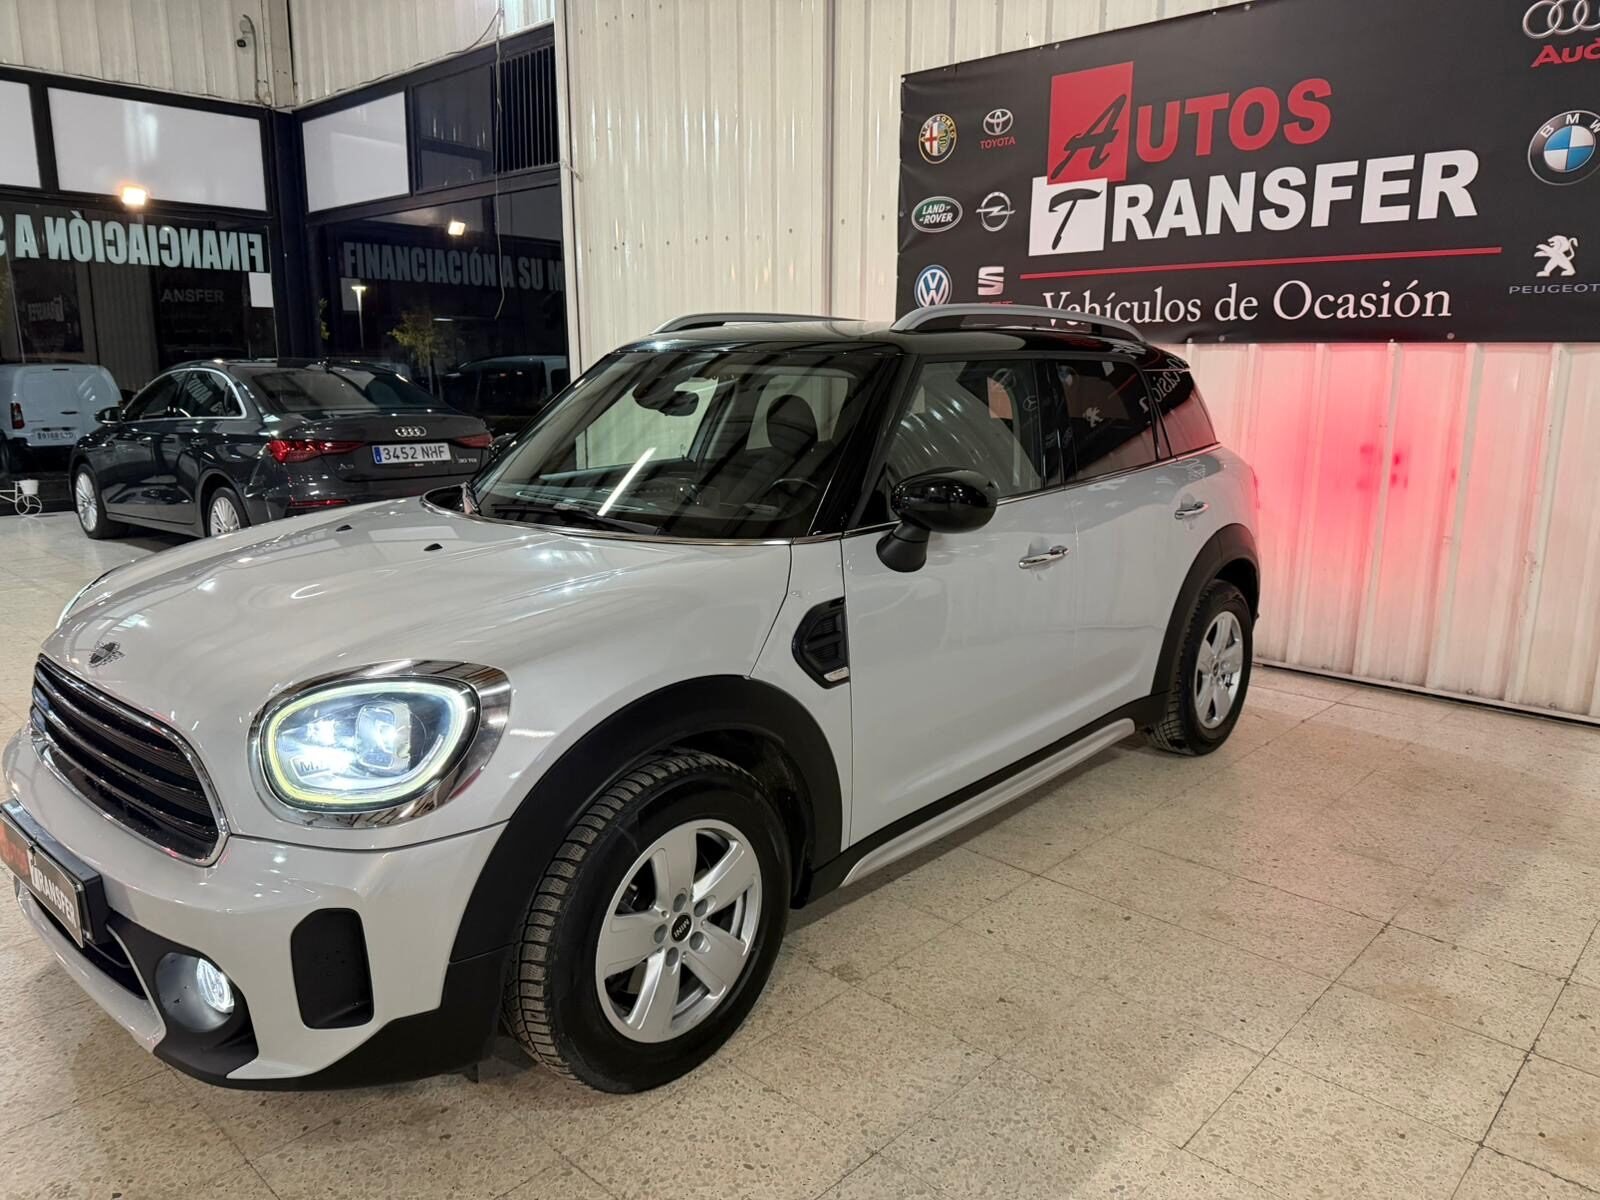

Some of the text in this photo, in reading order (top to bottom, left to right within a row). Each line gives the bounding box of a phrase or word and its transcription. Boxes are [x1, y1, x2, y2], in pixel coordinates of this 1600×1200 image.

[1051, 78, 1333, 181] AUTOS
[980, 136, 1016, 150] TOYOTA
[1047, 149, 1479, 250] TRANSFER
[922, 203, 945, 215] LAND
[923, 213, 953, 225] ROVER
[343, 241, 497, 287] FINANCIACIÓN
[501, 254, 515, 289] A
[518, 256, 543, 291] SU
[1509, 283, 1600, 295] PEUGEOT
[1042, 279, 1453, 327] Vehículos de Ocasión
[383, 445, 446, 461] 3452 NHF
[674, 918, 691, 938] MINI
